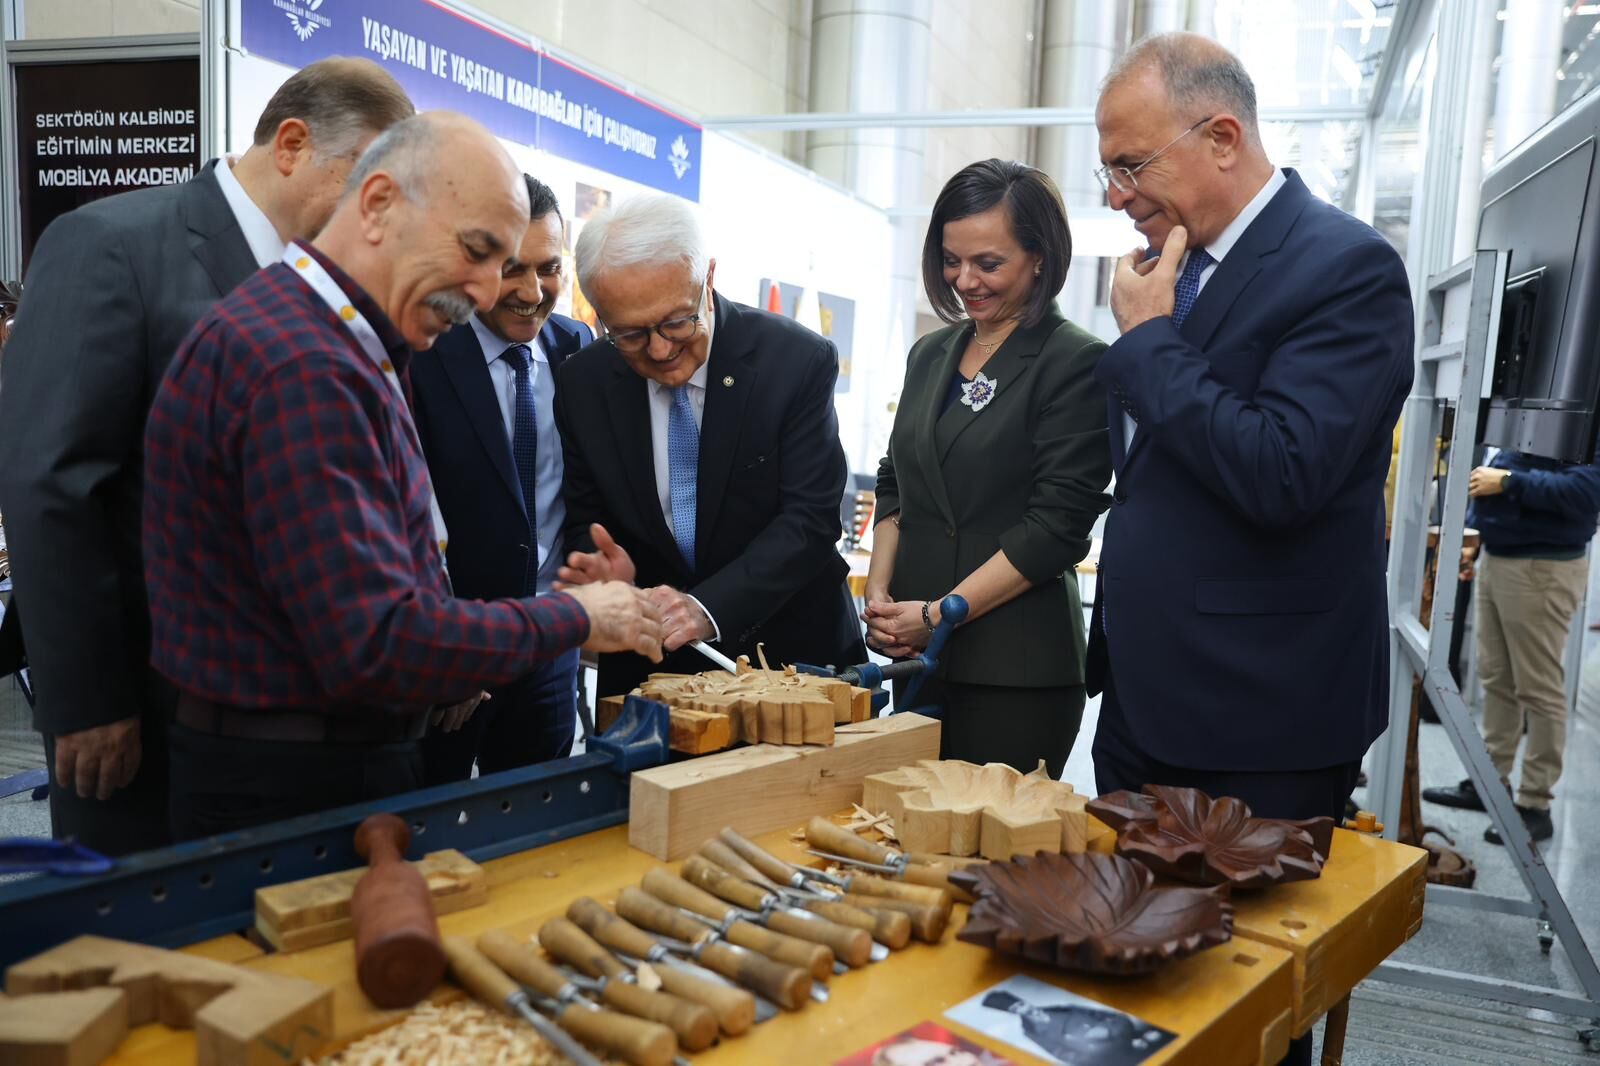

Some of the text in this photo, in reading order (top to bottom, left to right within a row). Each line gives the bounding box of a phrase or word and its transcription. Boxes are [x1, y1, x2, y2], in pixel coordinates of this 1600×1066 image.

[362, 16, 657, 160] YAŞAYAN VE YAŞATAN KARABAĞLAR İÇİN ÇALIŞIYORUZ
[36, 107, 195, 128] SEKTÖRÜN KALBİNDE
[36, 133, 195, 156] EĞİTİMİN MERKEZİ
[38, 163, 194, 187] MOBİLYA AKADEMİ
